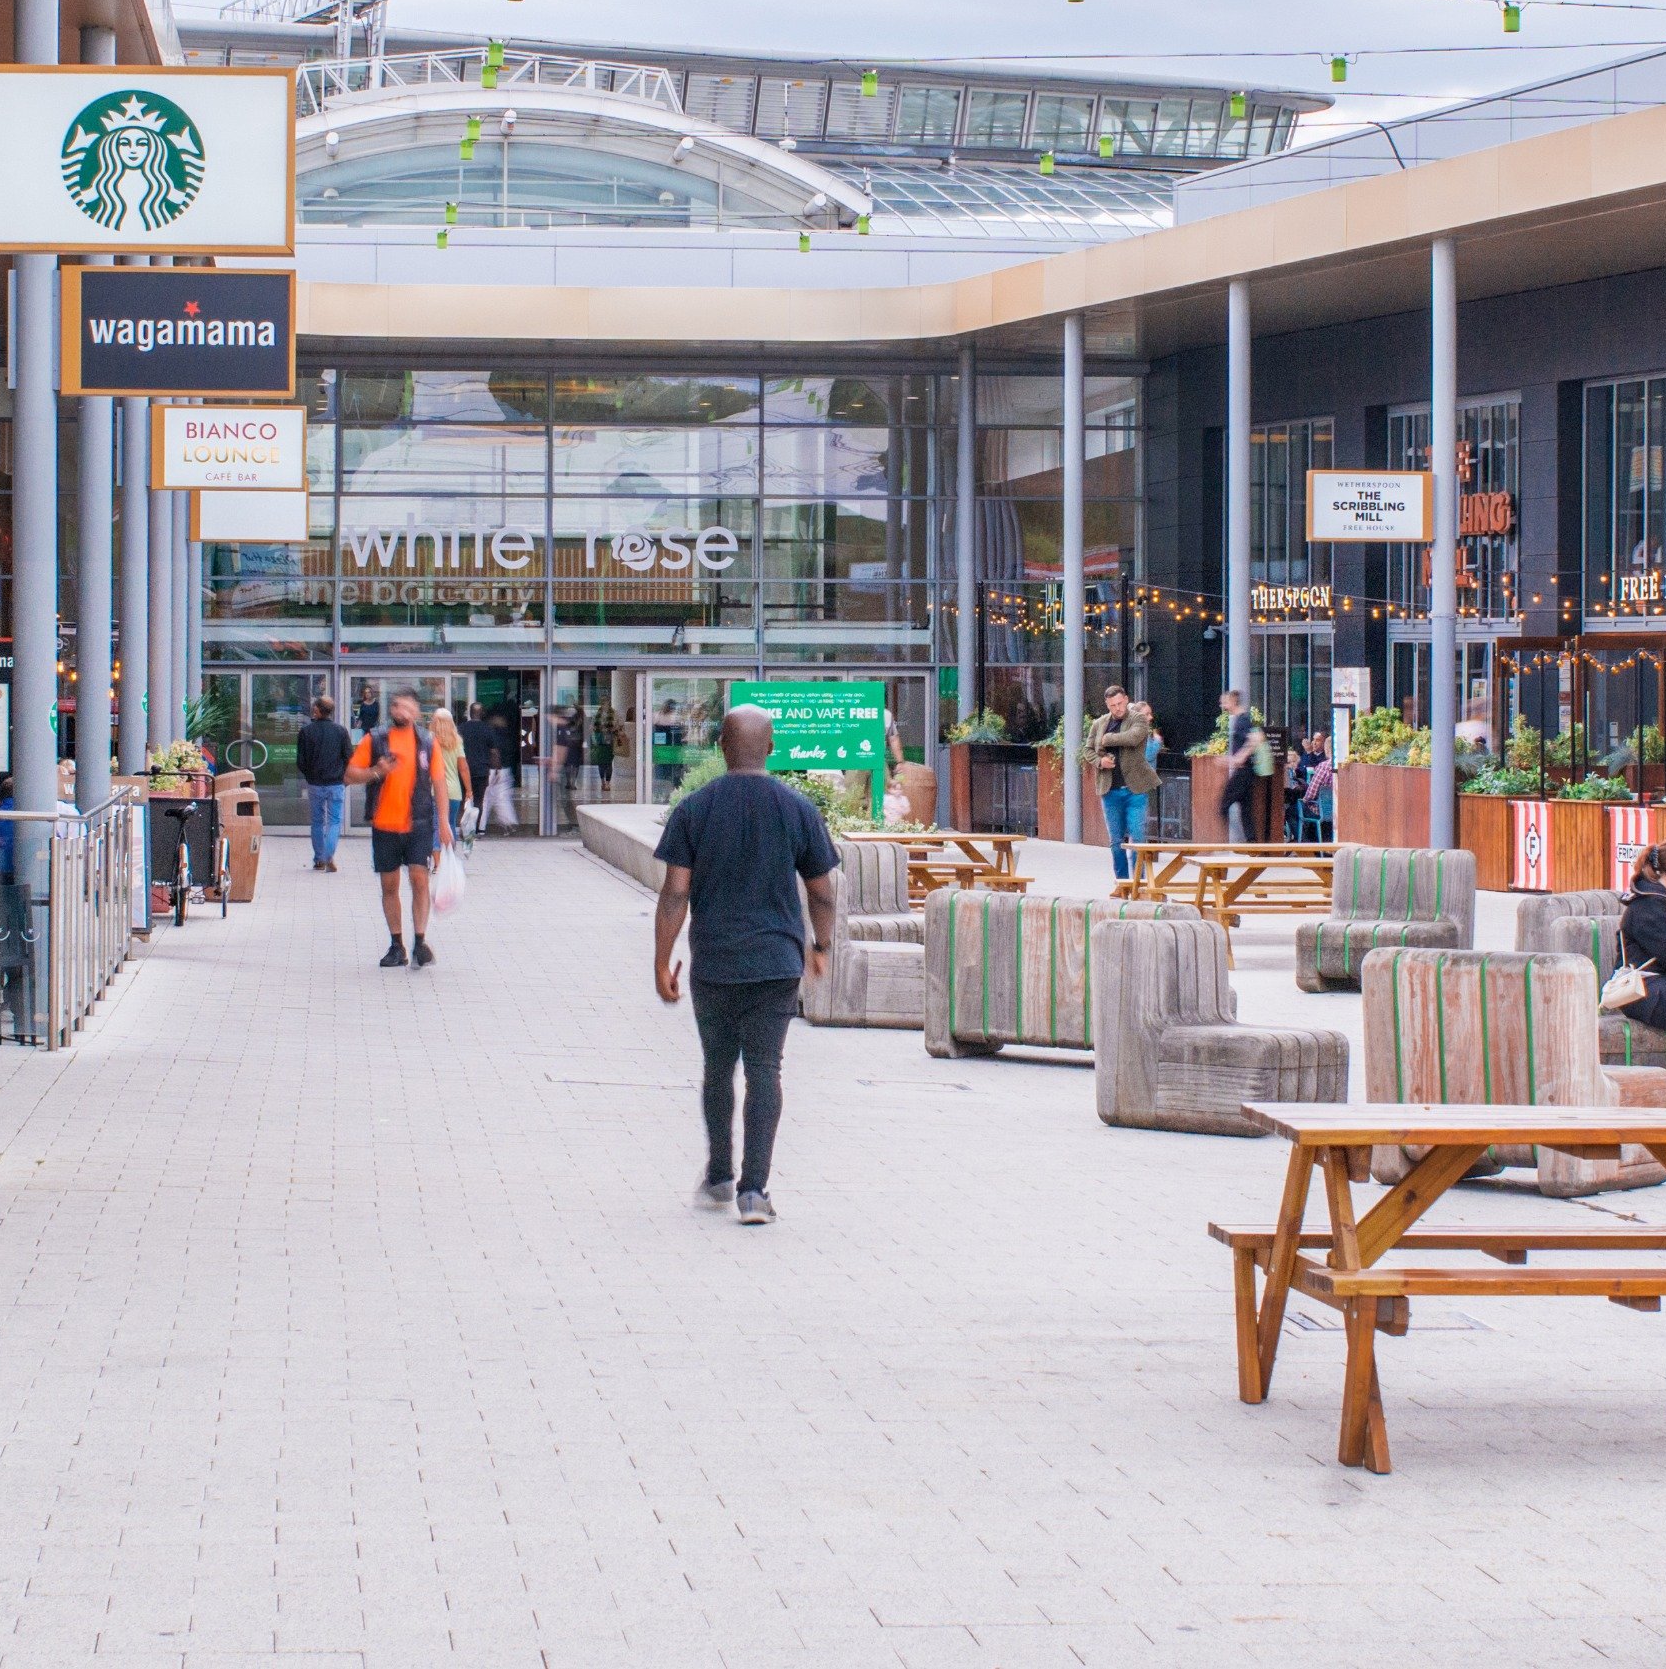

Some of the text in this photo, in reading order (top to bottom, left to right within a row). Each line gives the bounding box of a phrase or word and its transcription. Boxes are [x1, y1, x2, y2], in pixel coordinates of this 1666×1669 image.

[90, 317, 276, 351] wagamama
[186, 422, 277, 440] BIANCO
[183, 444, 280, 464] LOUNGE
[237, 473, 258, 482] BAR
[1337, 481, 1401, 489] WETHERSPOON
[1358, 491, 1381, 501] THE
[1332, 501, 1406, 512] SCRIBBLING
[1355, 512, 1383, 522] MILL
[347, 512, 740, 571] white rose
[1620, 575, 1660, 601] FREE
[1250, 584, 1331, 610] THERSPOON
[785, 707, 813, 719] AND
[816, 708, 845, 720] VAPE
[849, 708, 879, 720] FREE
[789, 744, 827, 760] thanks
